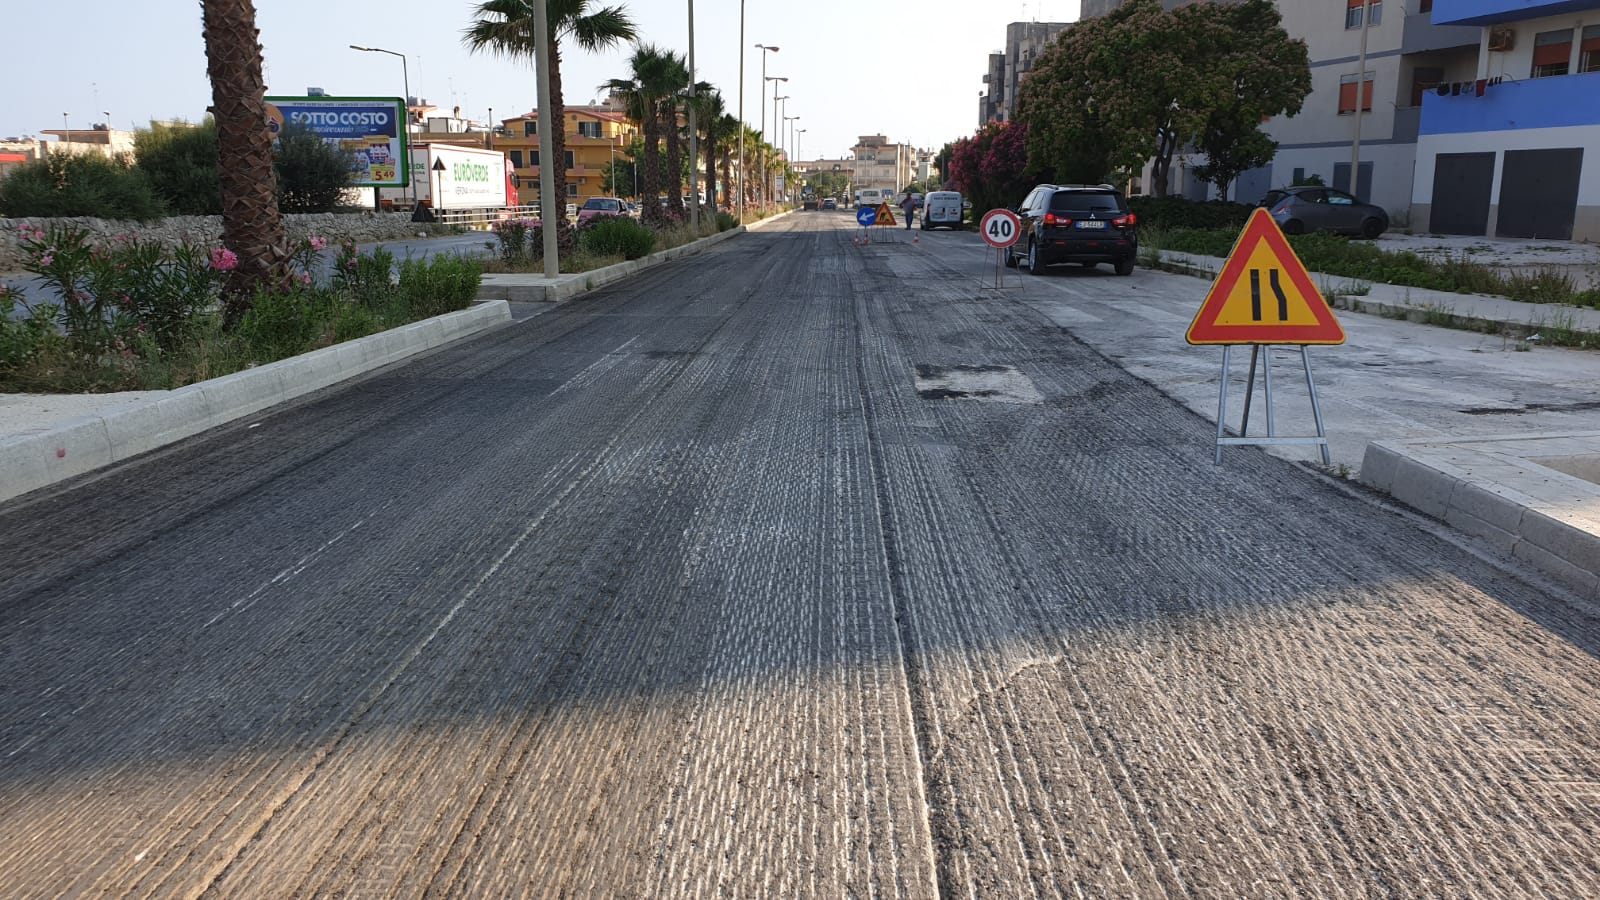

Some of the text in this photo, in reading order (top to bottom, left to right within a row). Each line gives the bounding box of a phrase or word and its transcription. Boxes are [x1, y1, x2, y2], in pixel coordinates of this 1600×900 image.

[291, 112, 388, 125] SOTTO COSTO
[989, 220, 1011, 237] 40
